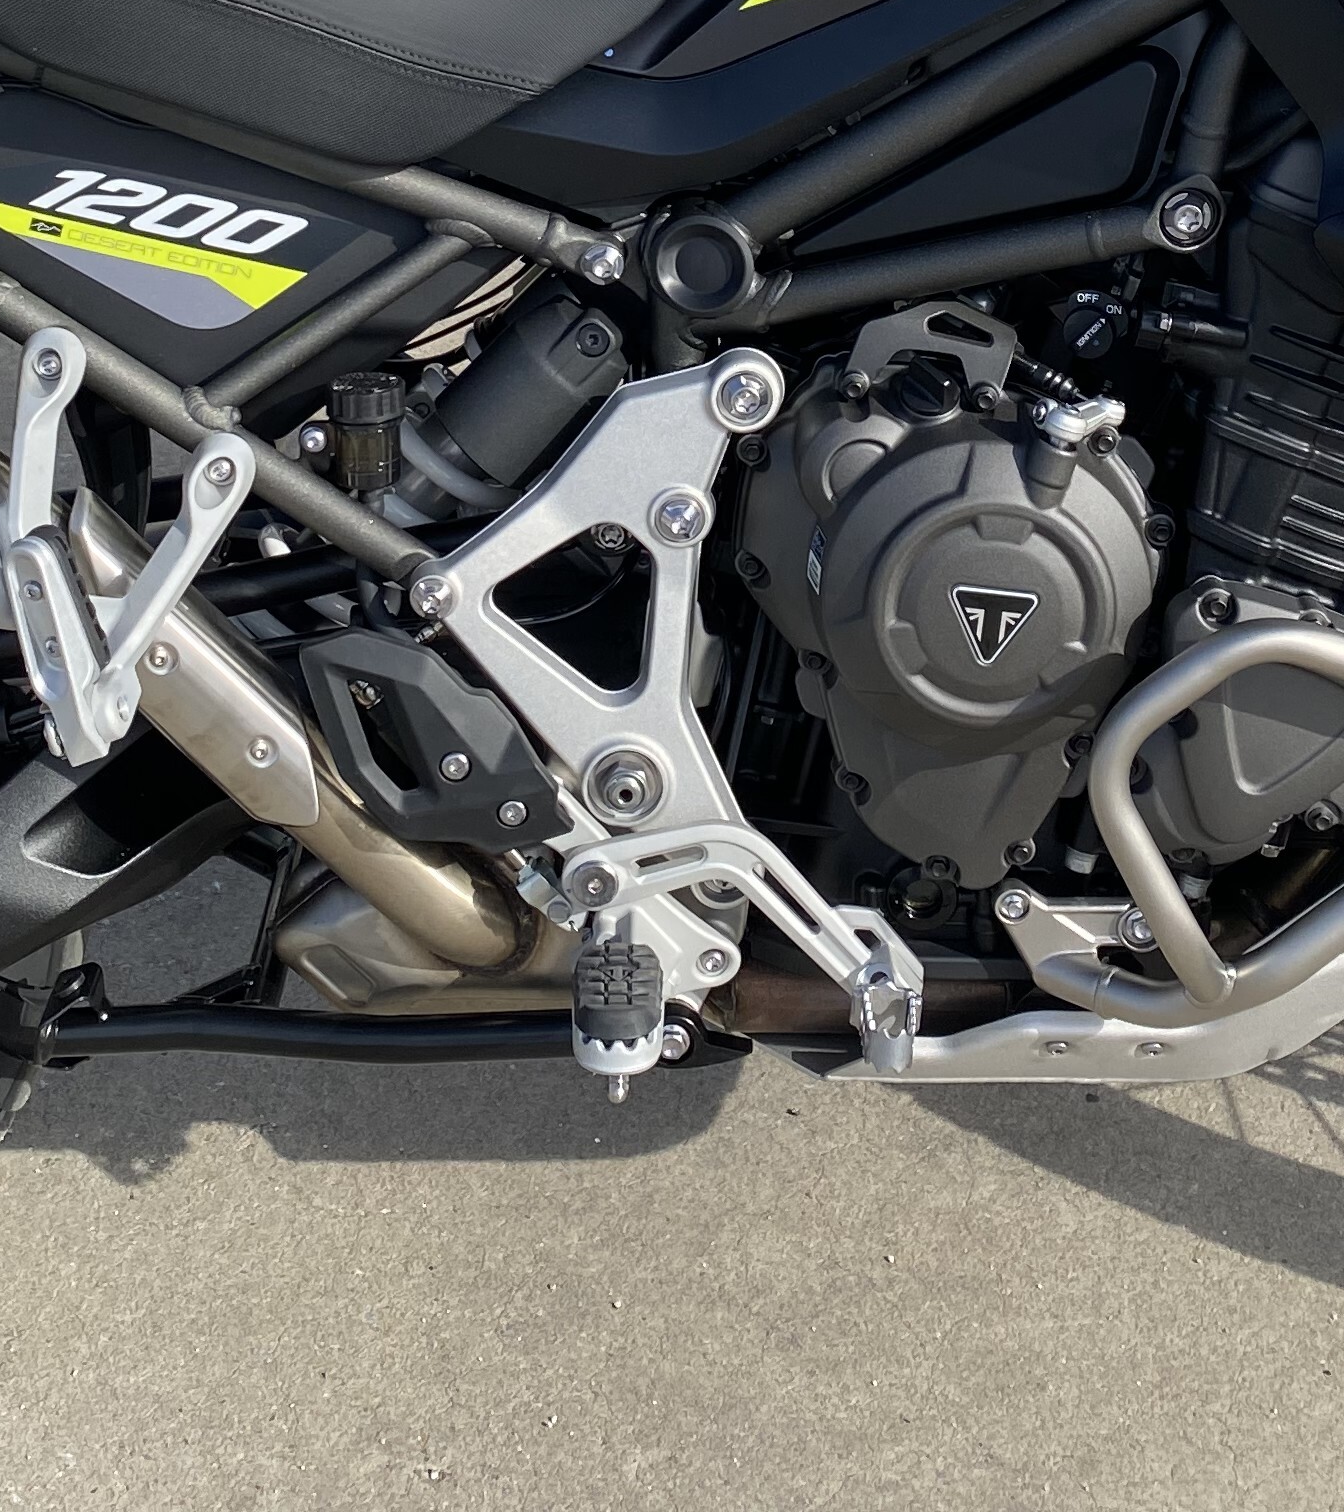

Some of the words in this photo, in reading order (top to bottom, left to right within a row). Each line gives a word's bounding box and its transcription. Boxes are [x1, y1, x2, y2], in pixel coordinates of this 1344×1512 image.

[28, 169, 309, 254] 1200
[67, 227, 163, 259] DESERT
[167, 248, 254, 280] EDITION
[1076, 292, 1100, 304] OFF
[1105, 304, 1123, 315] ON
